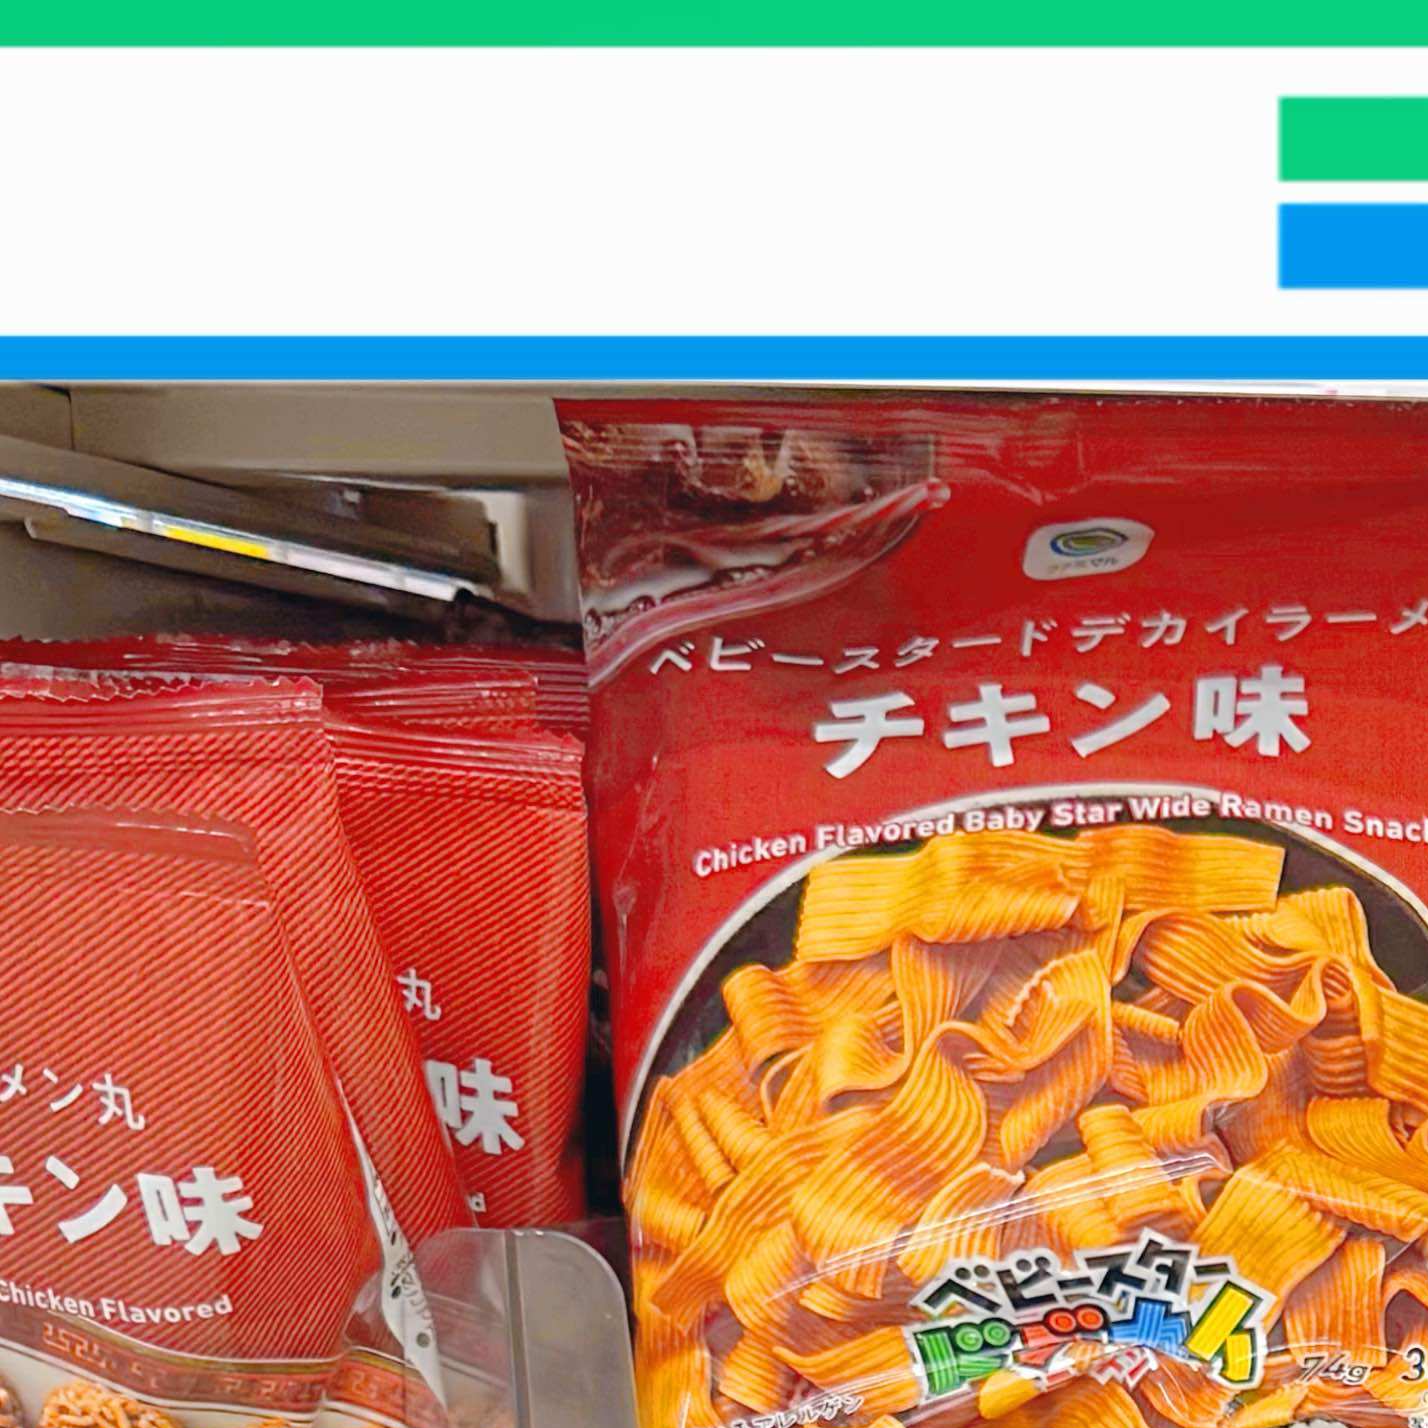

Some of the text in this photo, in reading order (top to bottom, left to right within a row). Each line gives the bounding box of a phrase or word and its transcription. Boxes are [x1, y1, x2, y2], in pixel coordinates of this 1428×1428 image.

[814, 665, 1314, 780] チキン味
[694, 831, 806, 878] Chicken
[817, 813, 957, 853] Flavored
[964, 800, 1045, 841] Baby
[1050, 800, 1121, 829] Star
[1129, 792, 1210, 824] Wide
[1220, 793, 1334, 832] Ramen
[425, 1056, 526, 1156] 味
[102, 1295, 235, 1325] Flavored
[923, 1236, 1232, 1316] ベビースター
[1301, 1353, 1370, 1385] 74g
